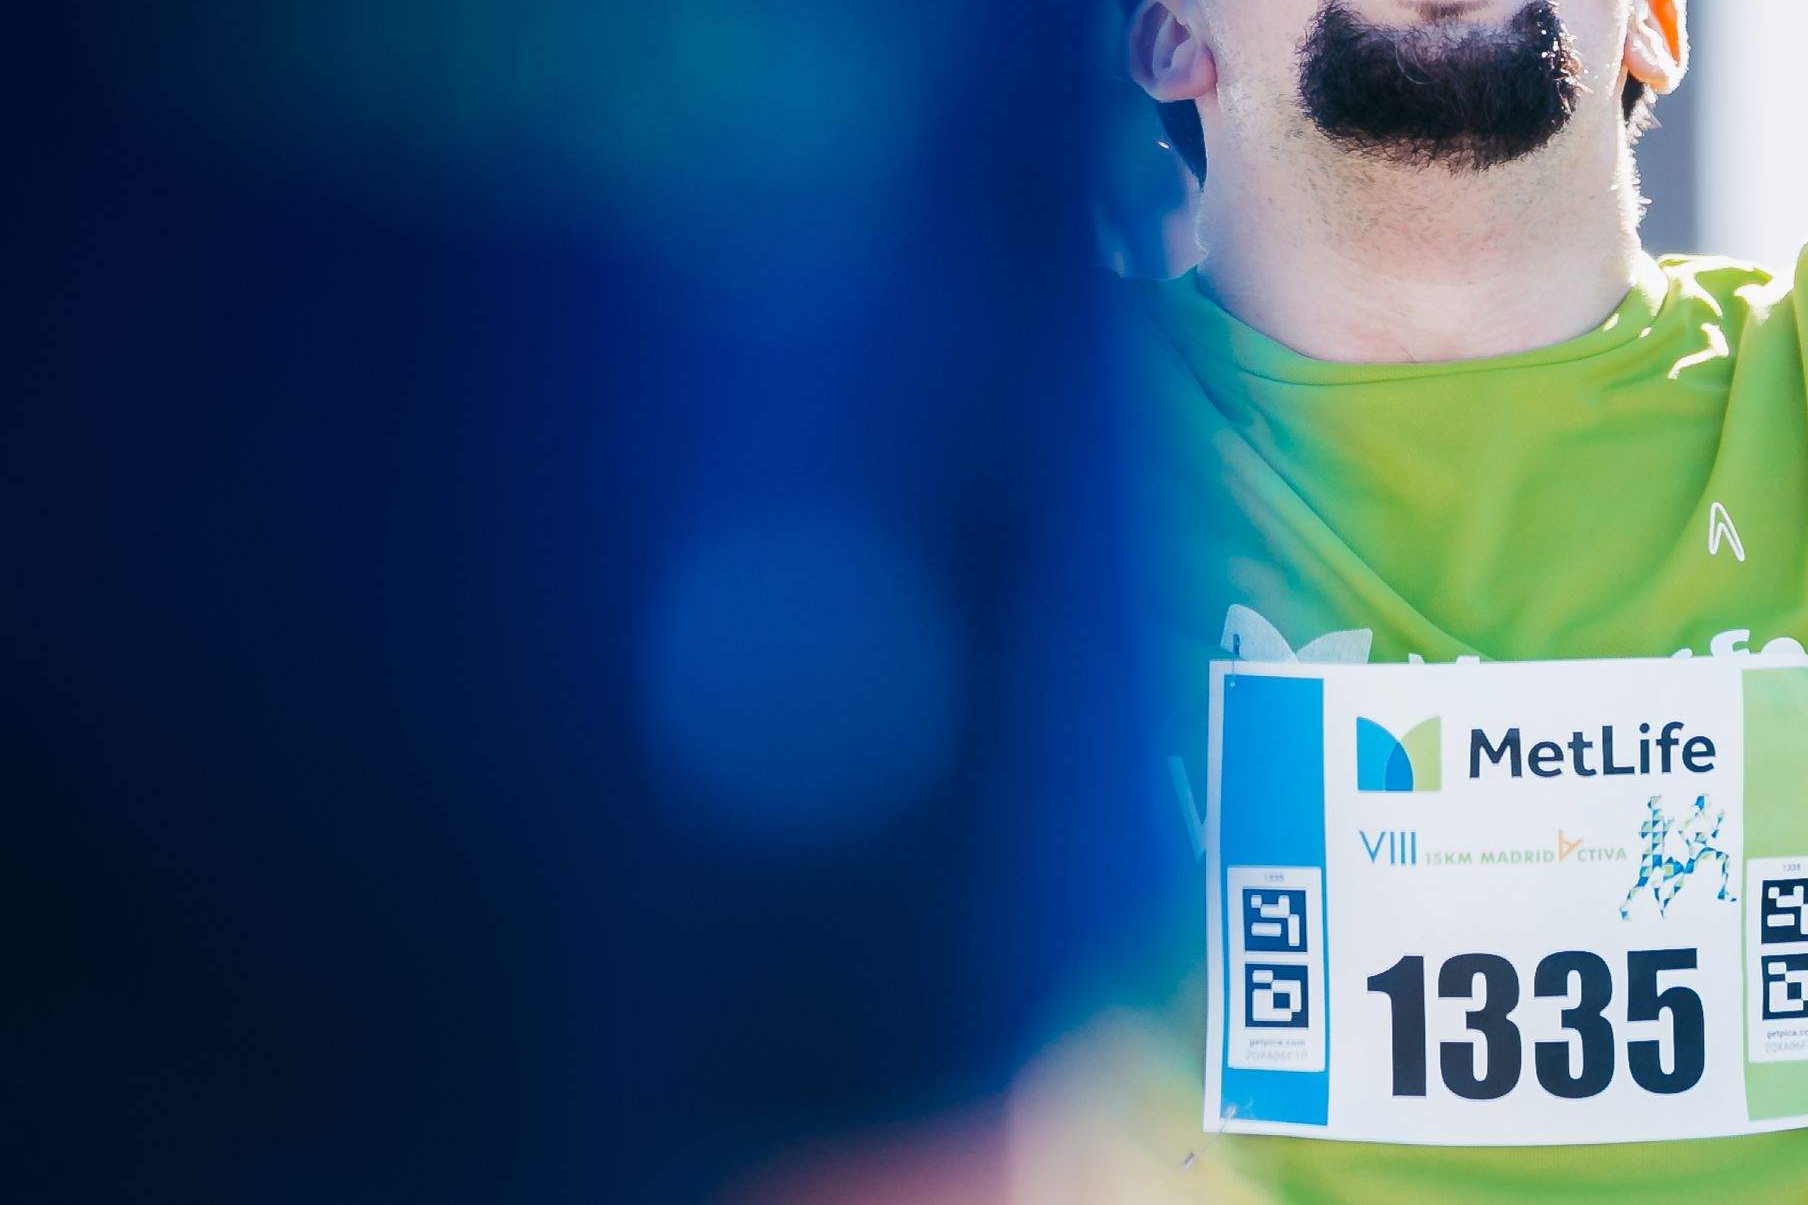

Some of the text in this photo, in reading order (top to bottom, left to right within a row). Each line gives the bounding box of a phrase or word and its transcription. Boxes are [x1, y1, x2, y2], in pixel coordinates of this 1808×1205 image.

[1469, 721, 1716, 778] MetLife
[1359, 830, 1417, 865] VIII
[1425, 850, 1473, 866] 15KM
[1480, 848, 1555, 865] MADRID
[1367, 947, 1706, 1100] 1335
